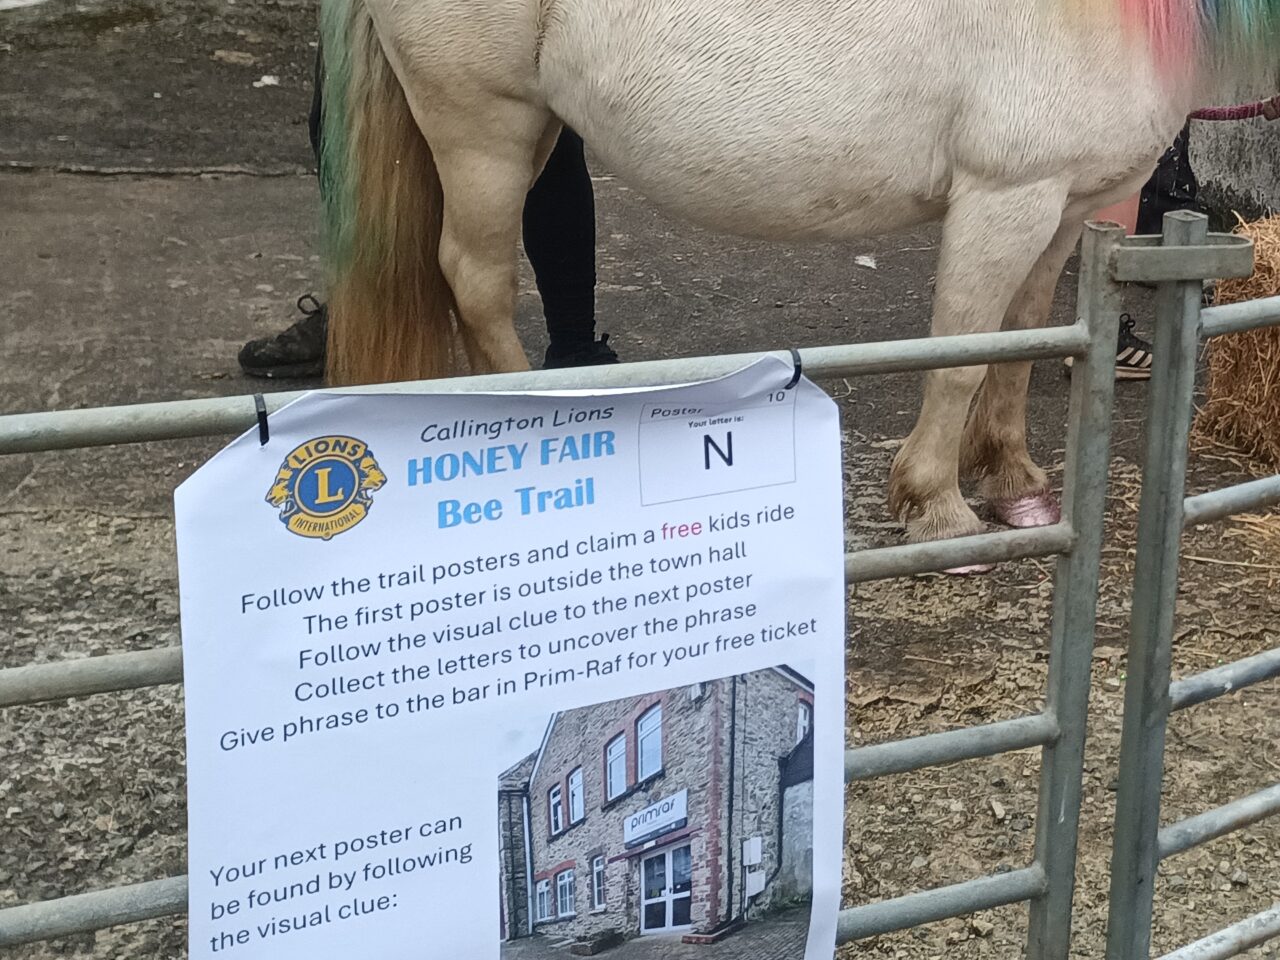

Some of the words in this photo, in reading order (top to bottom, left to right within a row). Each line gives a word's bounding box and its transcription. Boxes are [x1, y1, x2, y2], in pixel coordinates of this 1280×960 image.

[421, 416, 544, 443] Callington
[552, 406, 614, 428] Lions
[651, 407, 704, 418] Poster
[688, 420, 706, 428] Your
[708, 416, 732, 426] letter
[768, 392, 786, 403] 10
[293, 440, 360, 464] LIONS
[408, 442, 528, 486] HONEY
[540, 430, 616, 466] FAIR
[704, 431, 733, 470] N
[314, 468, 344, 504] L
[438, 498, 503, 529] Bee
[514, 477, 594, 516] Trail
[294, 508, 361, 532] INTERNATIONAL
[241, 585, 325, 614] Follow
[331, 578, 371, 597] the
[378, 564, 426, 590] trail
[432, 552, 520, 584] posters
[527, 540, 570, 564] and
[576, 530, 636, 556] claim
[642, 530, 656, 544] a
[661, 521, 702, 541] free
[708, 511, 750, 533] kids
[756, 504, 795, 525] ride
[302, 614, 348, 635] The
[355, 602, 404, 626] first
[410, 589, 486, 621] poster
[493, 582, 512, 602] is
[518, 568, 603, 598] outside
[608, 562, 644, 582] the
[650, 552, 702, 574] town
[708, 541, 748, 564] hall
[299, 641, 382, 669] Follow
[387, 632, 426, 652] the
[432, 616, 502, 644] visual
[508, 609, 558, 631] clue
[564, 603, 586, 620] to
[592, 596, 628, 616] the
[634, 585, 680, 608] next
[686, 572, 753, 601] poster
[294, 670, 386, 702] Collect
[392, 664, 430, 685] the
[438, 649, 513, 676] letters
[518, 642, 542, 660] to
[548, 625, 637, 655] uncover
[643, 617, 678, 636] the
[684, 601, 757, 634] phrase
[220, 726, 275, 752] Give
[283, 708, 368, 742] phrase
[375, 702, 400, 720] to
[406, 694, 445, 714] the
[452, 684, 490, 706] bar
[496, 678, 516, 696] in
[524, 655, 622, 691] Prim-Raf
[627, 649, 657, 669] for
[662, 640, 710, 667] your
[714, 632, 755, 652] free
[760, 618, 817, 643] ticket
[210, 858, 267, 887] Your
[274, 843, 326, 870] next
[334, 826, 412, 860] poster
[419, 816, 462, 838] can
[210, 899, 240, 920] be
[248, 874, 320, 908] found
[328, 870, 356, 891] by
[362, 842, 472, 882] following
[210, 929, 250, 952] the
[256, 904, 332, 939] visual
[338, 893, 398, 920] clue:
